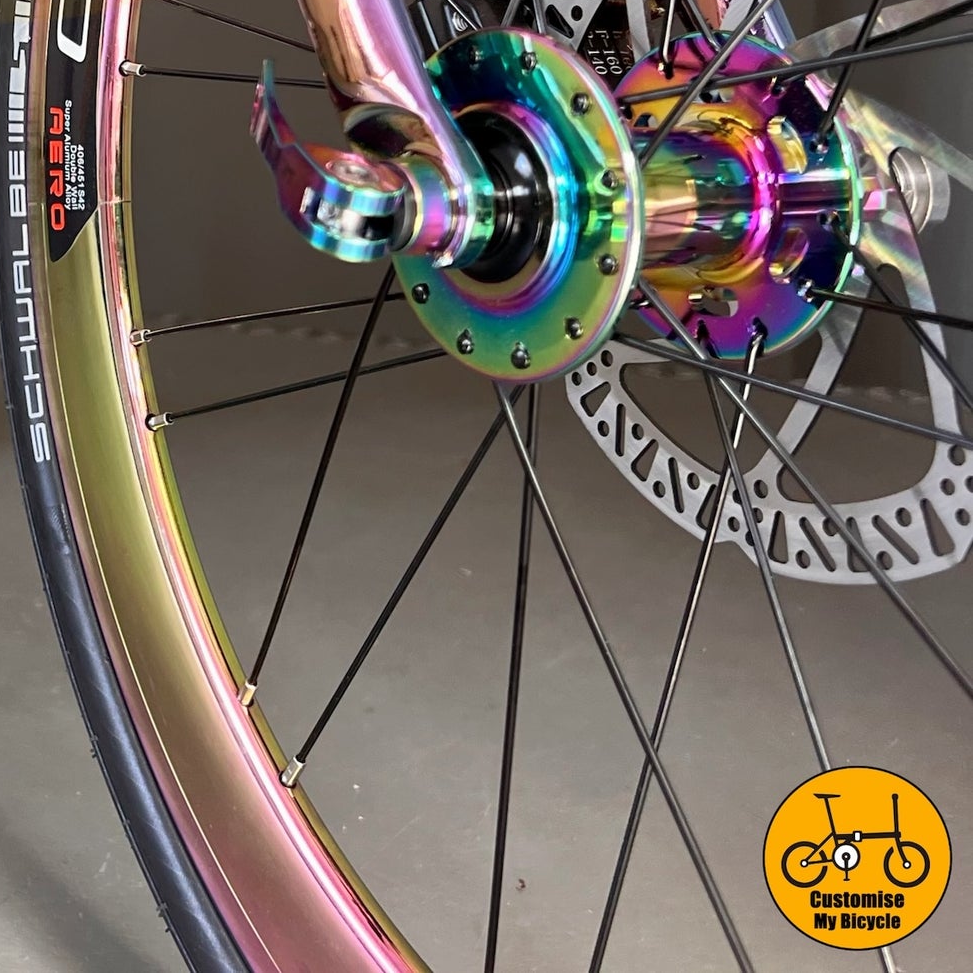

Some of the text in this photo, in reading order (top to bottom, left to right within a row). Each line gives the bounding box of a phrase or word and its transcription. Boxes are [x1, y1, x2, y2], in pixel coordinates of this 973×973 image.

[64, 99, 72, 133] Super
[49, 107, 65, 231] AERO
[64, 183, 72, 211] Alloy
[8, 149, 51, 463] SCHWALBE
